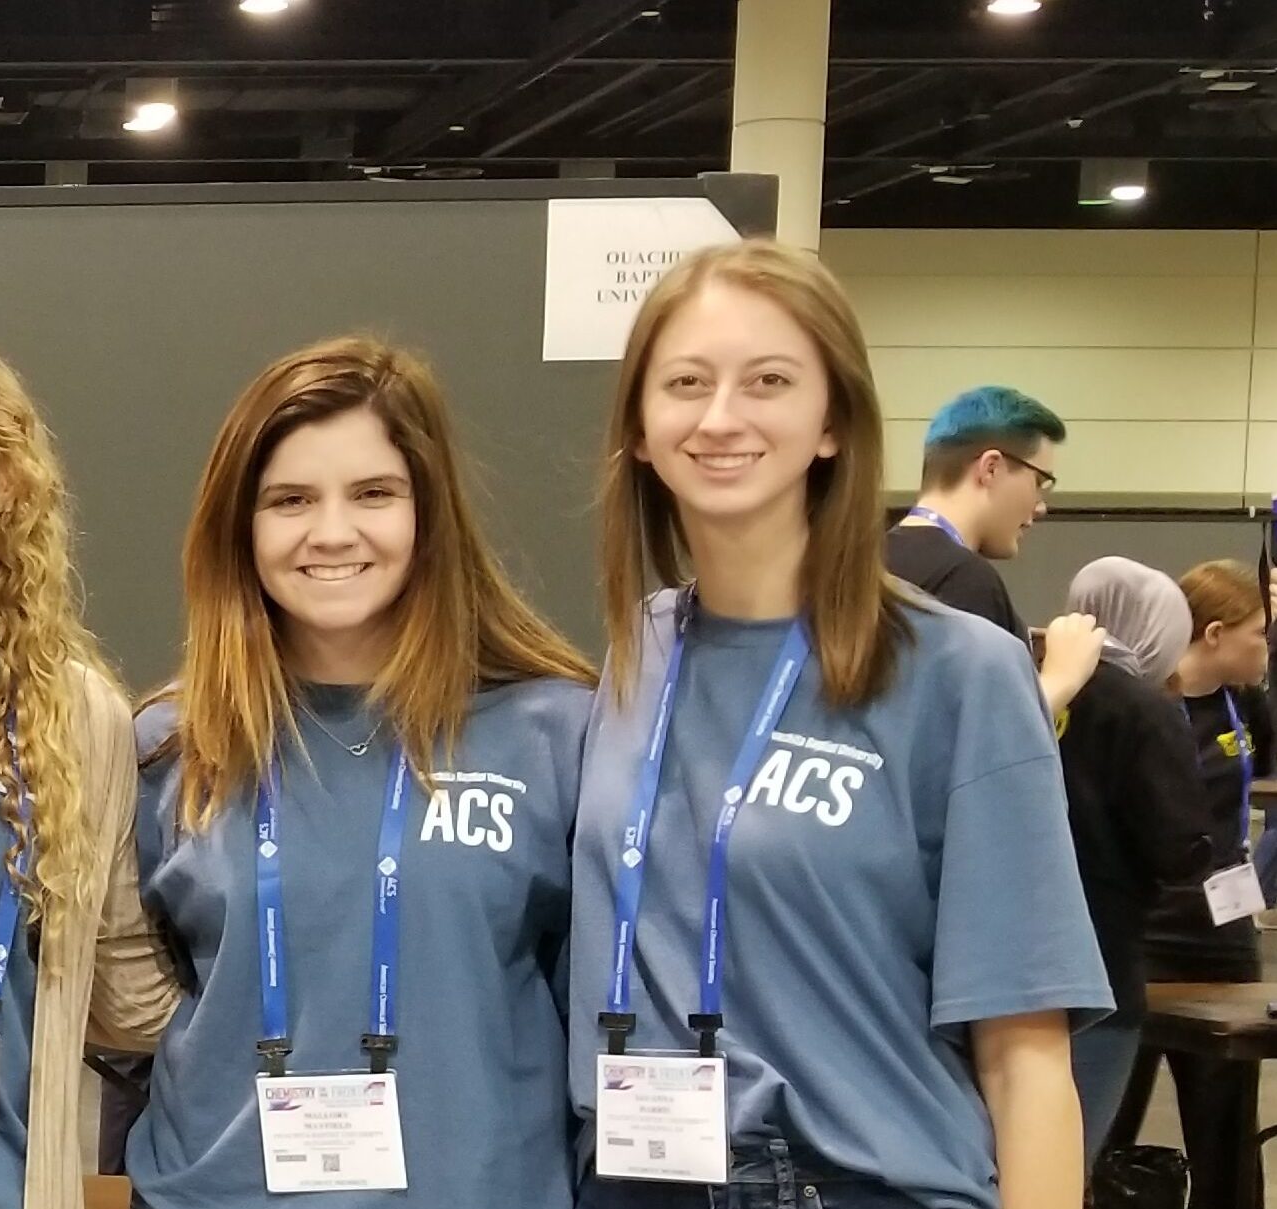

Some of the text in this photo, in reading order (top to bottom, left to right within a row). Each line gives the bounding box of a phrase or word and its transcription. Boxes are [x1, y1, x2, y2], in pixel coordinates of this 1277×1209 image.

[606, 250, 681, 264] OUACHI
[615, 269, 663, 284] BAPT
[746, 749, 865, 827] ACS
[420, 788, 514, 852] ACS
